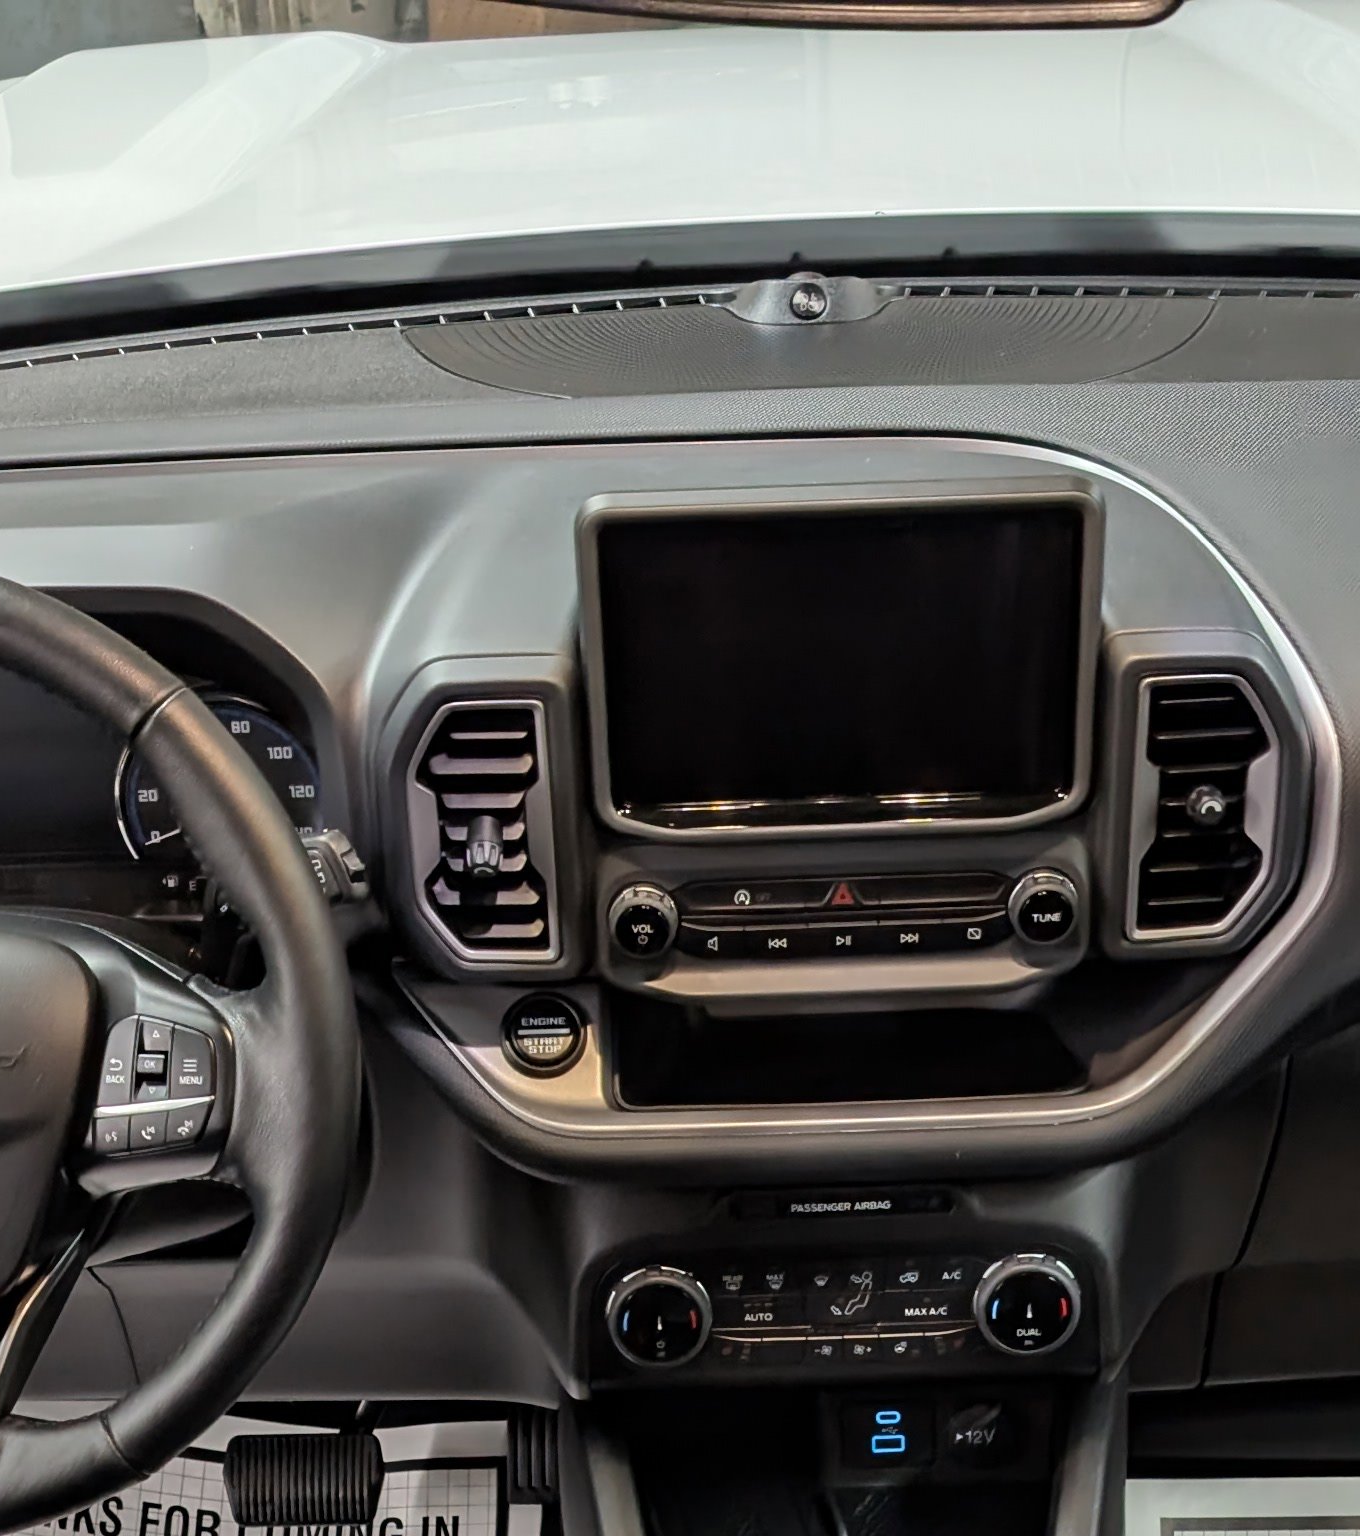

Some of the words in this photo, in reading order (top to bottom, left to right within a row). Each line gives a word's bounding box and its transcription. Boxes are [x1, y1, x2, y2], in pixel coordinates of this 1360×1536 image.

[231, 720, 251, 734] 80
[267, 746, 293, 760] 100
[138, 789, 159, 803] 20
[288, 785, 315, 798] 120
[1031, 912, 1062, 924] TUNE
[631, 924, 655, 934] VOL
[521, 1017, 566, 1027] ENGINE
[523, 1037, 565, 1046] START
[528, 1045, 562, 1054] STOP
[144, 1060, 155, 1069] OK
[105, 1075, 125, 1084] BACK
[179, 1076, 203, 1085] MENU
[791, 1202, 852, 1213] PASSENGER
[854, 1200, 891, 1211] AIRBAG
[942, 1271, 962, 1280] A/C
[904, 1308, 927, 1317] MAX
[929, 1306, 948, 1316] A/C
[744, 1313, 773, 1322] AUTO
[1016, 1328, 1042, 1337] DUAL
